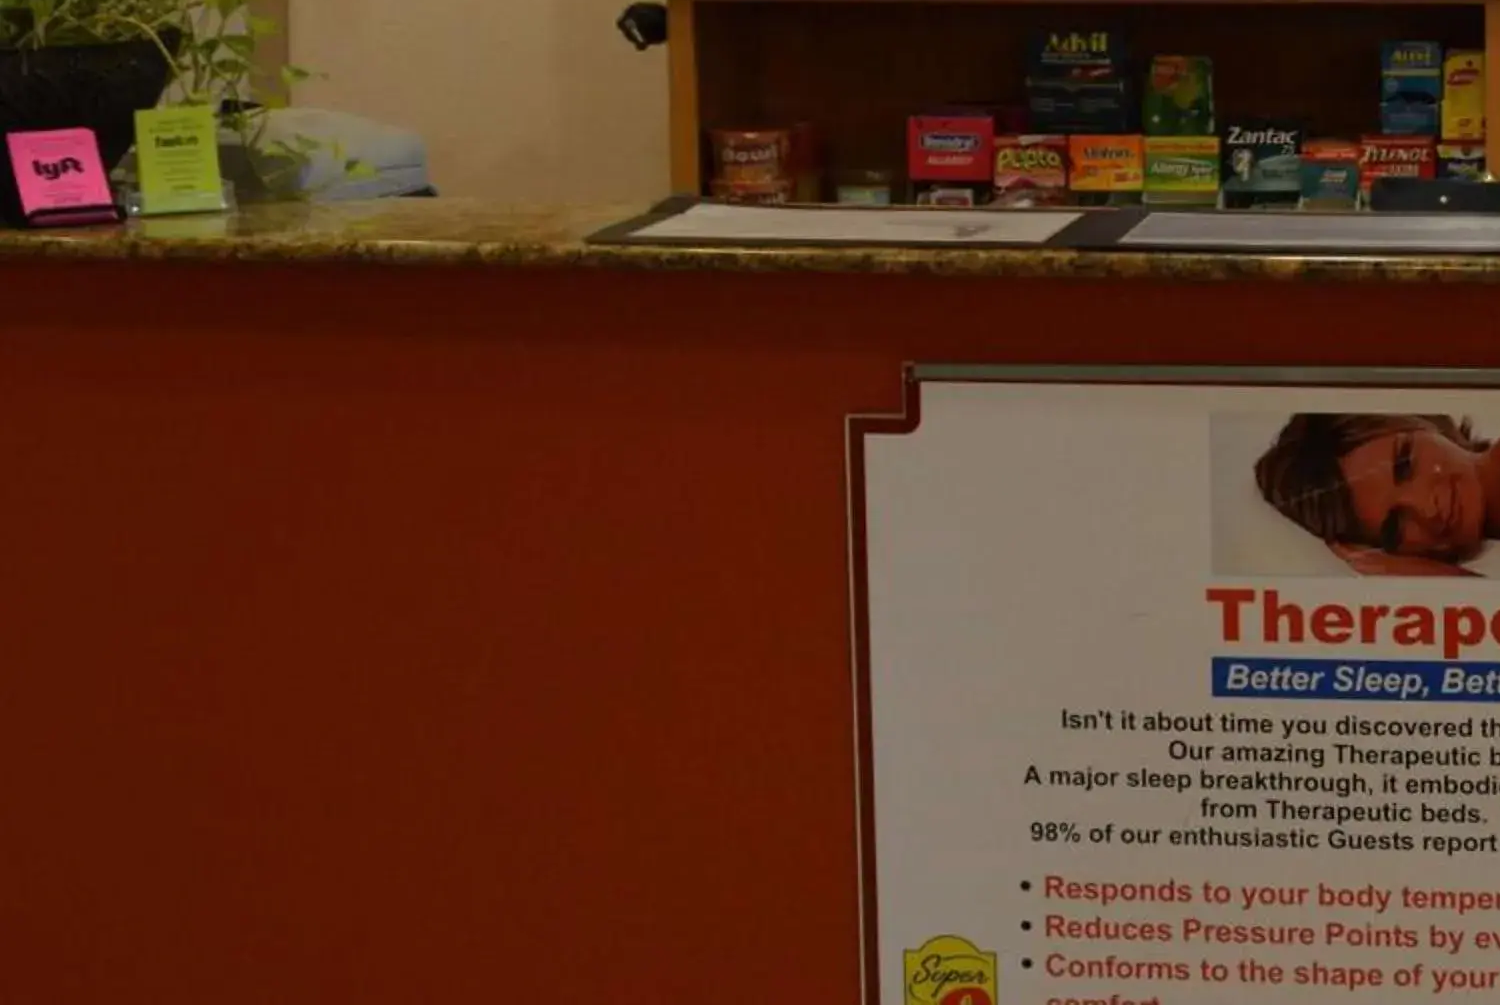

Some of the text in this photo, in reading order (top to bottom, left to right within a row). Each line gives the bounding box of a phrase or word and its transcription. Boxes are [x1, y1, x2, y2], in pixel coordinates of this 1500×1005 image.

[1045, 32, 1109, 52] Advil
[1227, 125, 1299, 144] Zantac
[32, 158, 84, 180] lyft
[999, 146, 1061, 171] Pepto
[1227, 664, 1325, 690] Better
[1333, 666, 1429, 699] Sleep,
[1061, 708, 1113, 731] Isn't
[1120, 710, 1137, 731] it
[1142, 711, 1214, 733] about
[1219, 712, 1274, 734] time
[1281, 719, 1327, 740] you
[1335, 714, 1473, 738] discovered
[1168, 739, 1215, 761] Our
[1221, 743, 1325, 769] amazing
[1332, 743, 1481, 770] Therapeutic
[1023, 764, 1042, 785] A
[1049, 767, 1120, 792] major
[1126, 767, 1192, 794] sleep
[1199, 769, 1373, 798] breakthrough,
[1382, 773, 1398, 794] it
[1200, 797, 1257, 819] from
[1265, 799, 1413, 826] Therapeutic
[1421, 802, 1488, 824] beds.
[1030, 821, 1081, 844] 98%
[1088, 823, 1114, 844] of
[1120, 828, 1162, 845] our
[1168, 825, 1320, 849] enthusiastic
[1327, 828, 1415, 851] Guests
[1422, 834, 1498, 857] report
[1044, 875, 1193, 906] Responds
[1202, 882, 1232, 905] to
[1241, 886, 1310, 911] your
[1318, 882, 1392, 914] body
[1045, 914, 1173, 942] Reduces
[1183, 918, 1315, 946] Pressure
[1325, 922, 1419, 948] Points
[1429, 925, 1465, 955] by
[913, 953, 991, 997] Super
[1045, 952, 1191, 981] Conforms
[1200, 959, 1229, 982] to
[1237, 959, 1284, 984] the
[1294, 961, 1384, 992] shape
[1393, 963, 1423, 987] of
[1431, 970, 1500, 994] your
